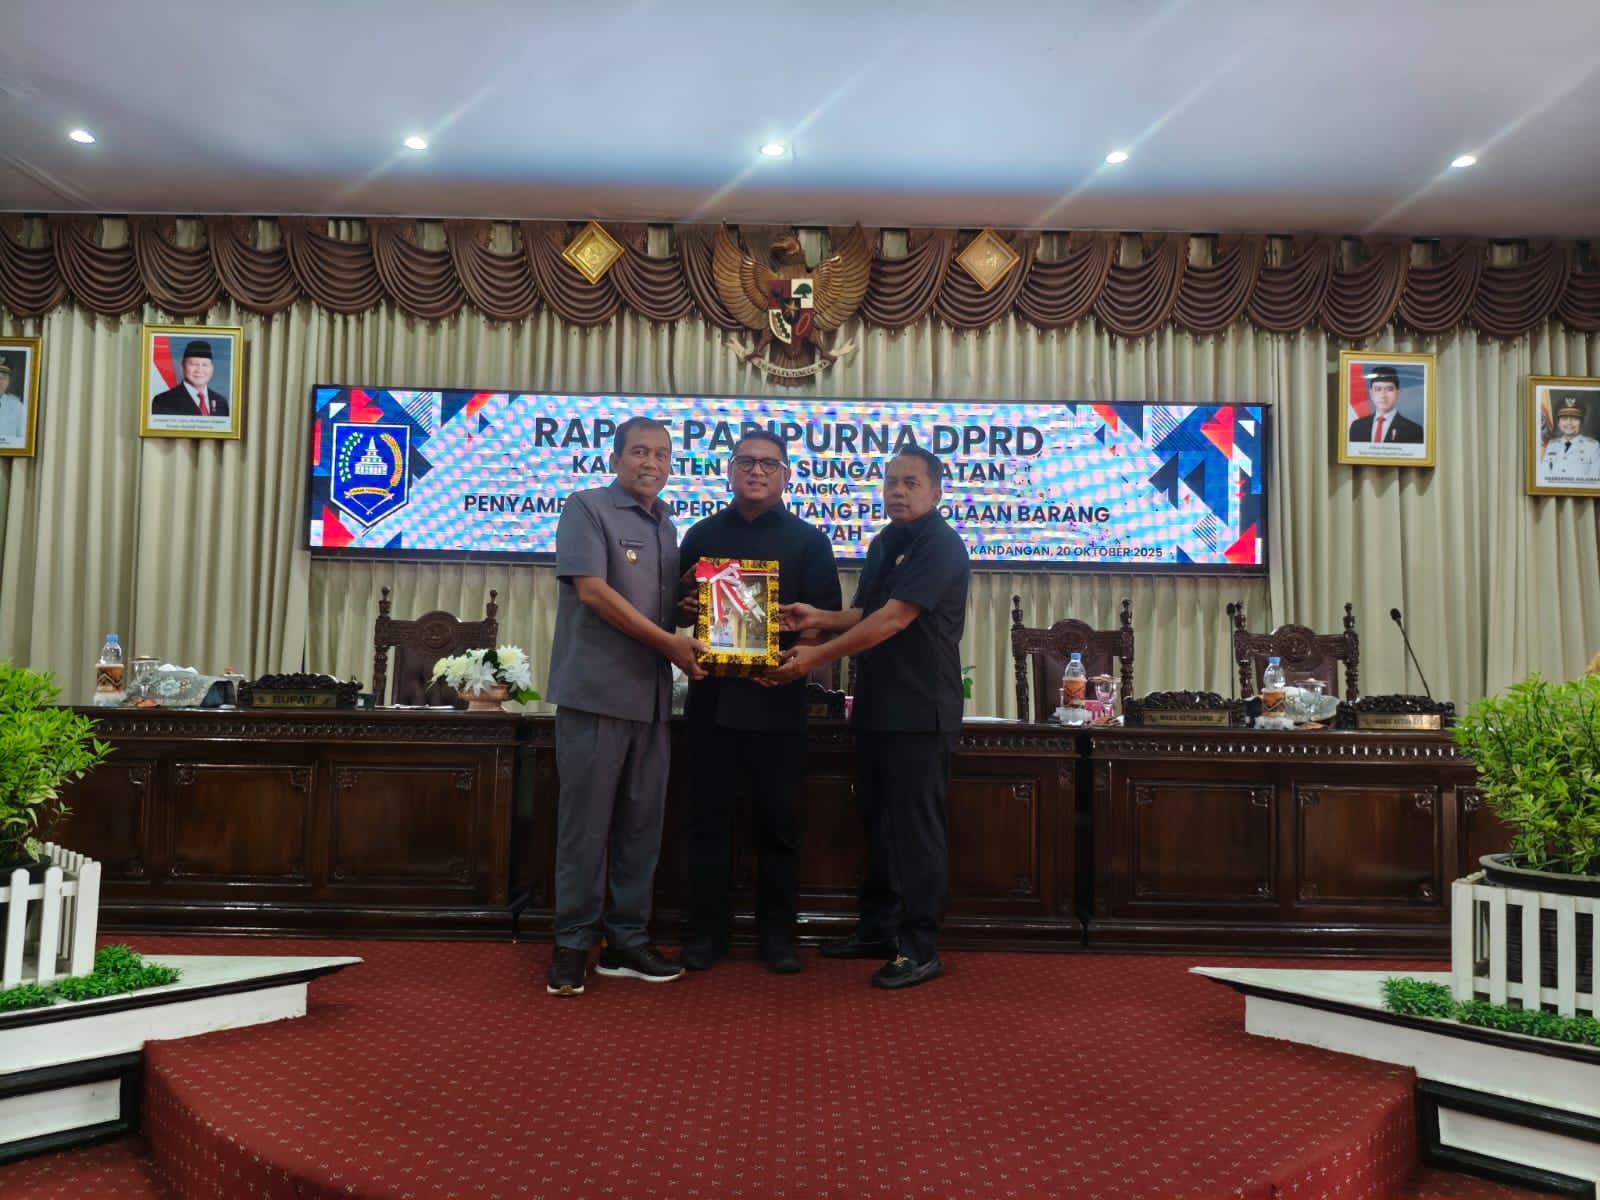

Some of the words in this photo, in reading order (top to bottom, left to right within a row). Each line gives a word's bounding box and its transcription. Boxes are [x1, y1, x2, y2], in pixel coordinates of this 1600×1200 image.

[535, 417, 672, 449] RAP
[933, 424, 1044, 456] DPRD
[573, 455, 721, 476] KATEN
[942, 462, 1005, 482] ATAN
[784, 482, 850, 496] RANGKA
[464, 495, 568, 513] PENYAMP
[787, 502, 852, 519] TANG
[858, 503, 1012, 522] PEOLAAN
[1018, 505, 1110, 523] BARANG
[820, 524, 862, 541] RAH
[970, 545, 1054, 558] KANDANGAN,
[1057, 546, 1070, 557] 20
[1073, 546, 1130, 558] OKTOBER
[1134, 547, 1162, 558] 2025
